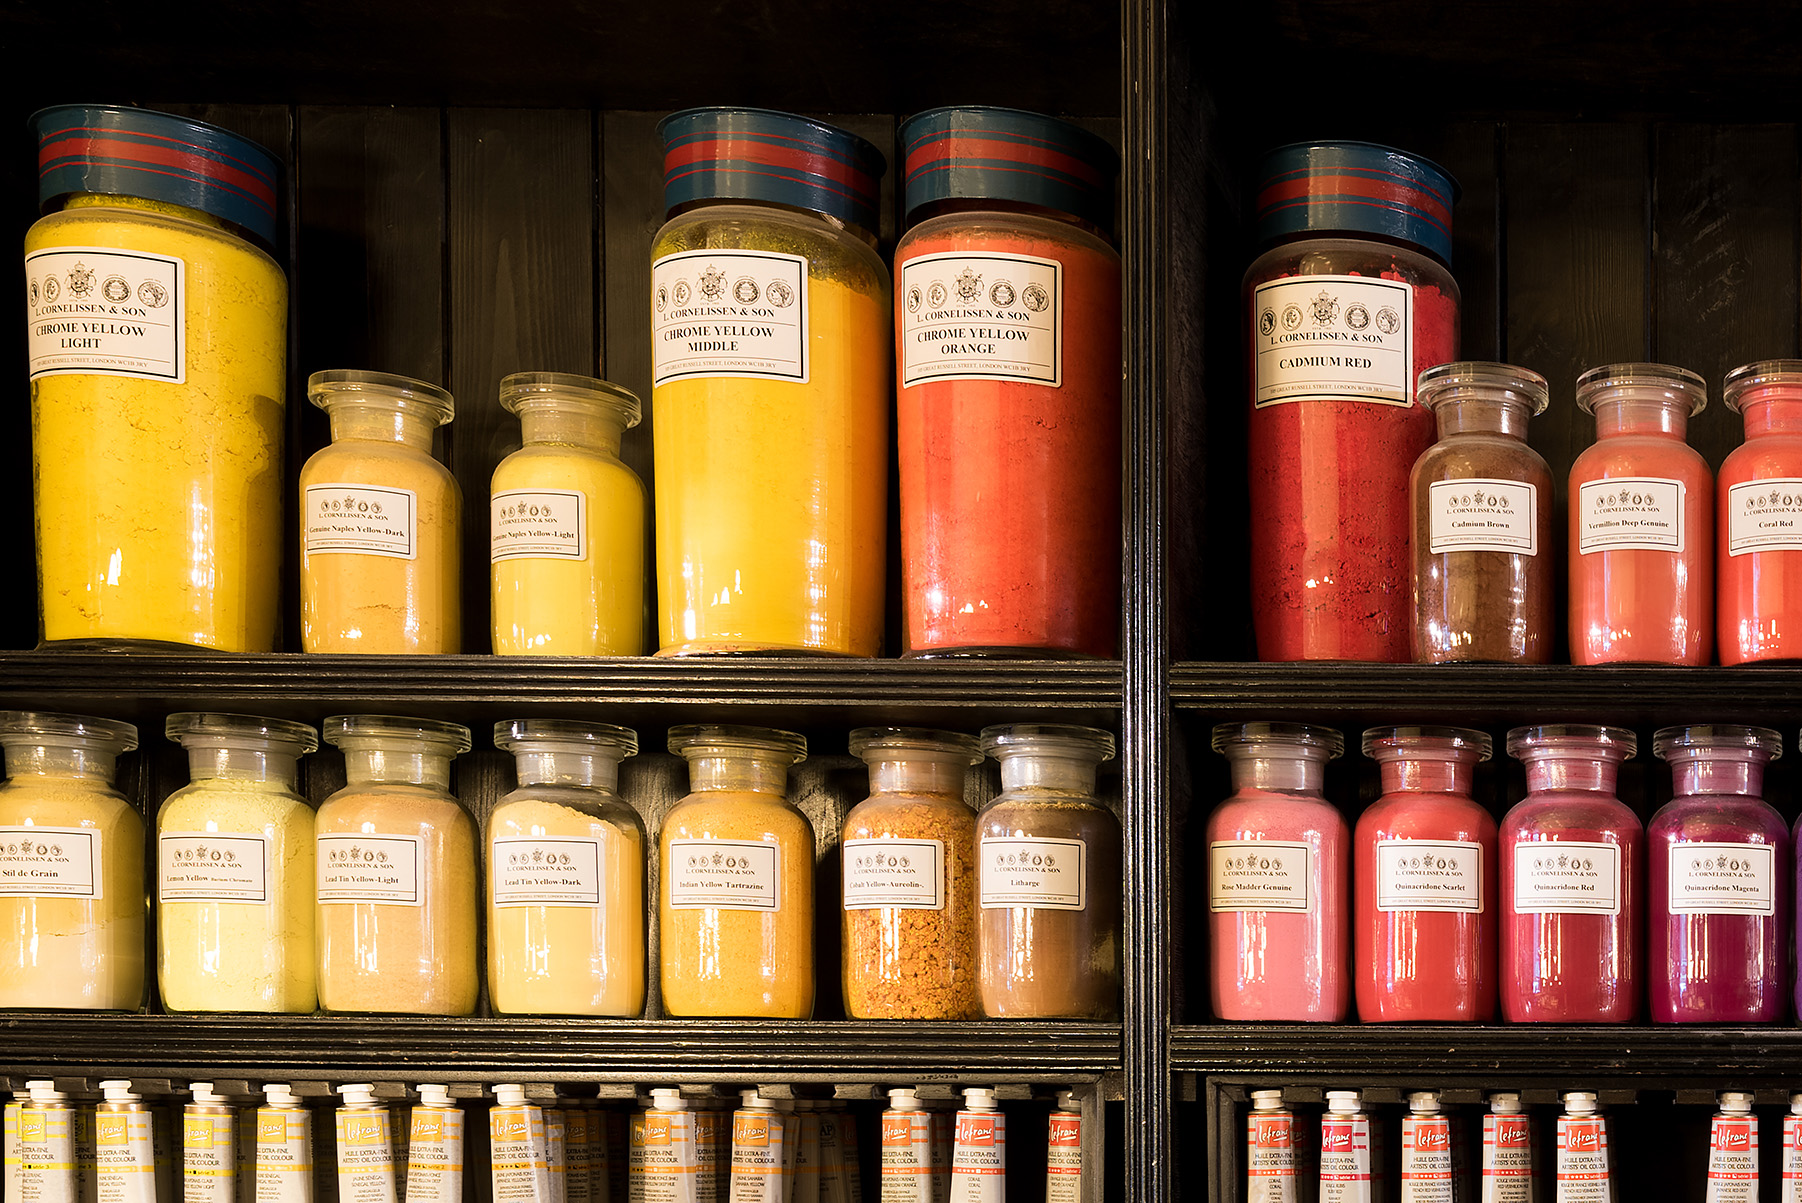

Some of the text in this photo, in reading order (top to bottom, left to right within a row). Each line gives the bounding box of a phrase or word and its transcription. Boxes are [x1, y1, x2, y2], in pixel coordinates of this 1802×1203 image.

[671, 308, 737, 320] CORNELISSEN
[740, 308, 748, 317] &
[752, 308, 775, 317] SON
[36, 323, 146, 337] CHROME YELLOW
[664, 326, 775, 342] CHROME YELLOW
[918, 329, 1030, 342] CHROME YELLOW
[1271, 332, 1383, 344] L. CORNELISSEN & SON
[61, 338, 102, 348] LIGHT
[689, 341, 738, 352] MIDDLE
[941, 344, 996, 354] ORANGE
[1280, 357, 1372, 369] CADMIUM RED
[1622, 520, 1639, 528] Deep
[1641, 520, 1669, 528] Genuine
[357, 526, 405, 537] Yellow-Dark
[508, 532, 526, 540] Naples
[528, 530, 574, 539] Yellow-Light
[2, 870, 58, 878] Stil de Grain
[351, 876, 399, 884] Yellow-Light
[726, 882, 764, 890] Tartrazine
[1395, 883, 1441, 891] Quinacridone
[1685, 885, 1759, 894] Quinacridone Magenta
